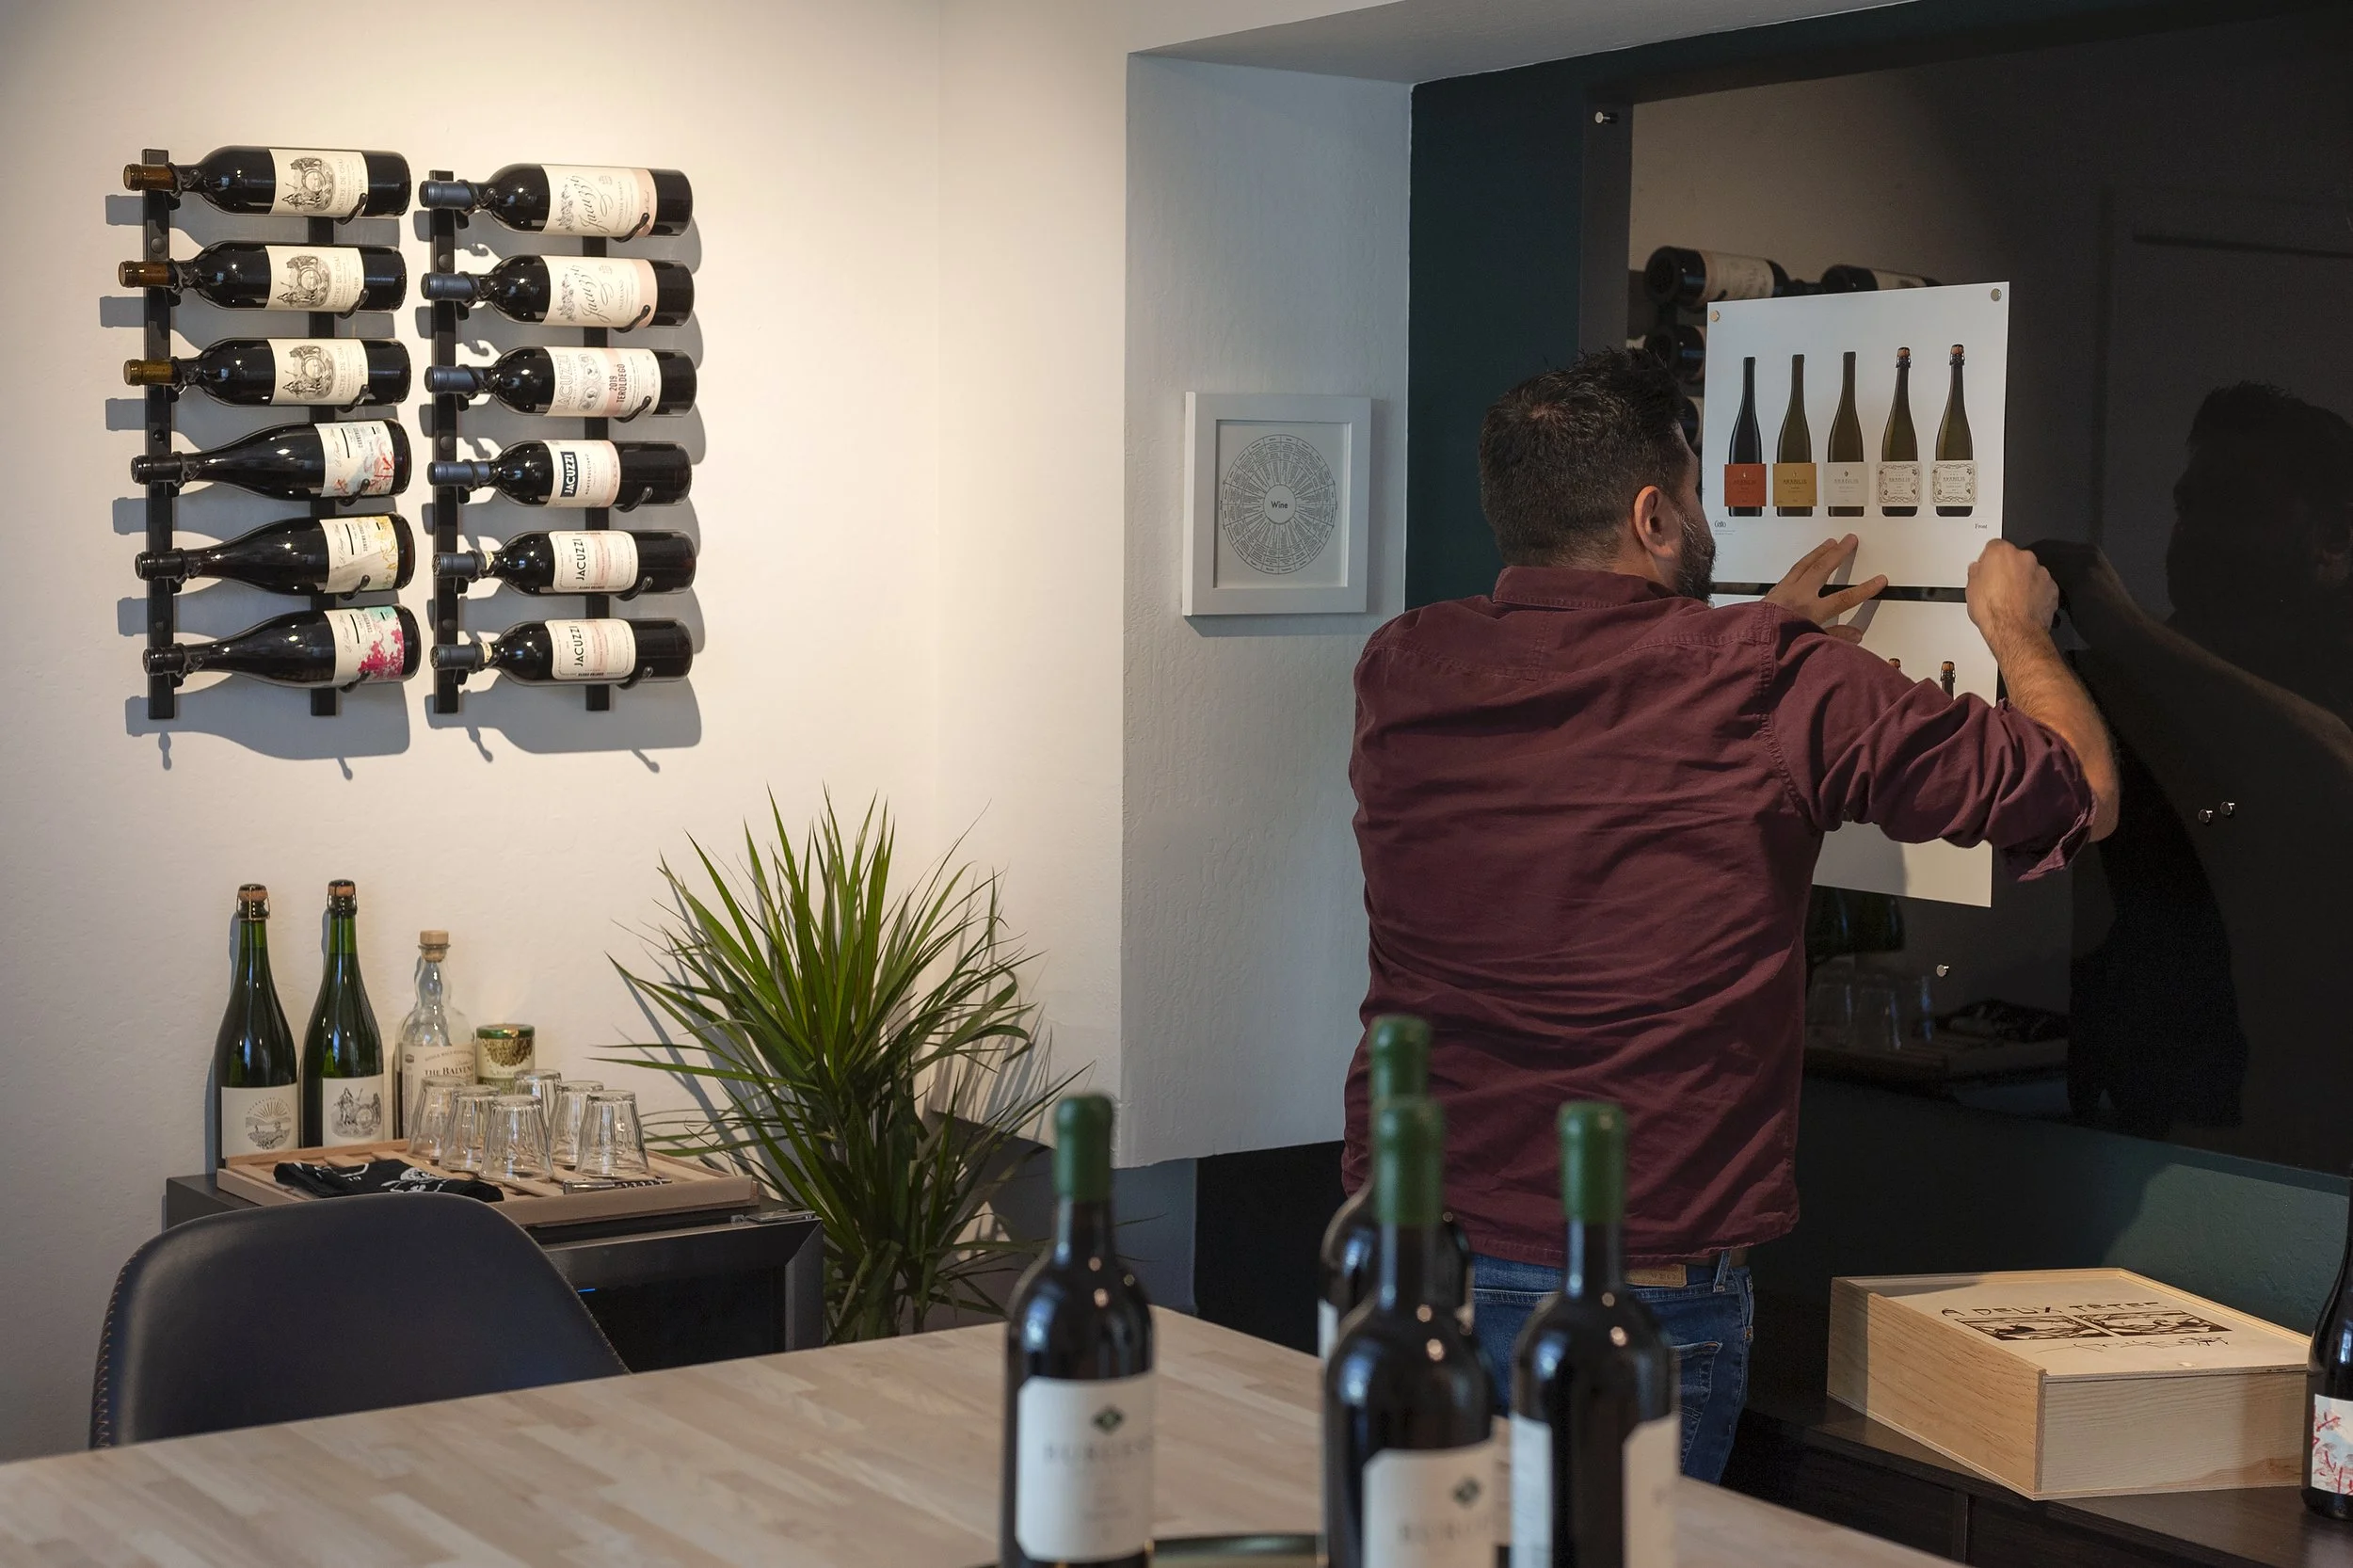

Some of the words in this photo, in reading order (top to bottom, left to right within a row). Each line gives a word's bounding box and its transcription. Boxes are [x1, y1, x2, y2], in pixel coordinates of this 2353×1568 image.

[565, 175, 611, 233] Jacuzzi
[566, 264, 612, 323] Jacuzzi
[554, 354, 574, 409] JACUZZI
[608, 376, 617, 392] 2019
[616, 363, 628, 404] TEROLDEGO
[564, 454, 577, 494] JACUZZI
[1271, 501, 1289, 509] Wine
[571, 538, 587, 581] JACUZZI
[568, 625, 584, 667] JACUZZI
